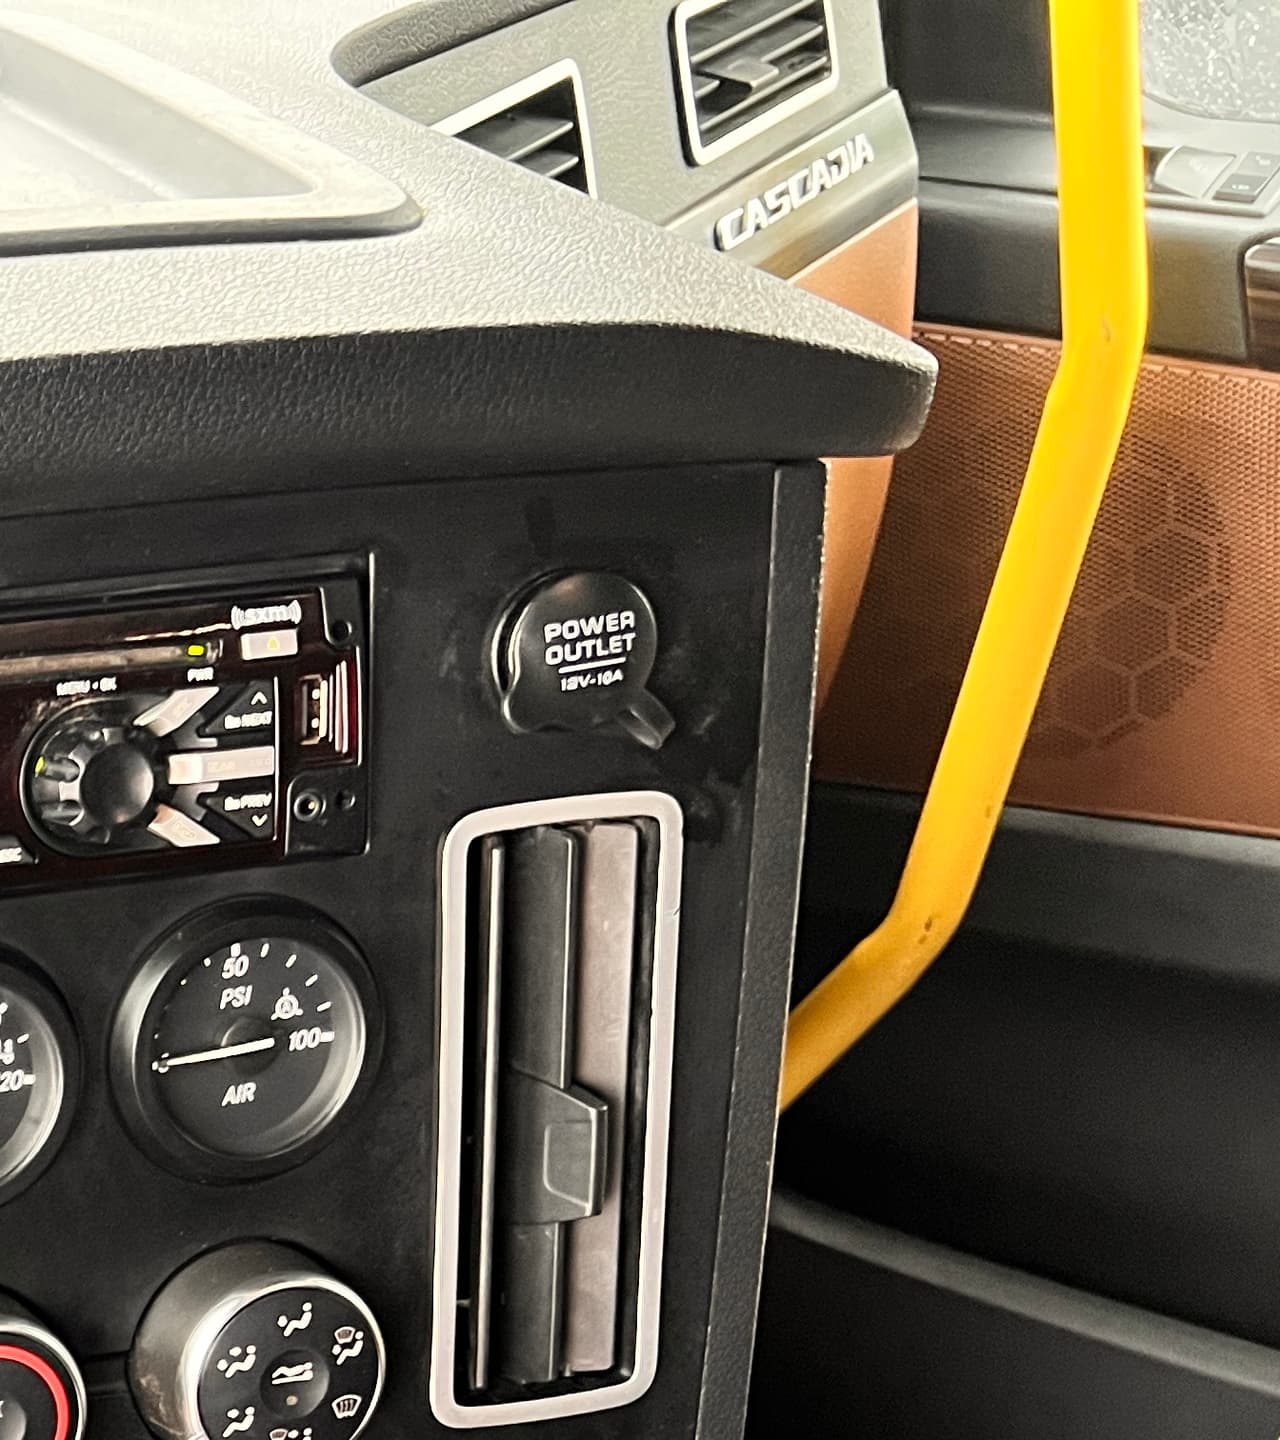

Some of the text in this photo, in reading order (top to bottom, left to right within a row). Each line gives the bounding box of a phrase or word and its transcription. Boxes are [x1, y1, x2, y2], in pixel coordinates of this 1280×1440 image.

[716, 133, 874, 250] CASCADIA
[544, 611, 635, 643] POWER
[545, 633, 636, 665] OUTLET
[221, 955, 249, 979] 50
[220, 985, 253, 1009] PSI
[289, 1027, 321, 1051] 100
[222, 1082, 256, 1106] AIR
